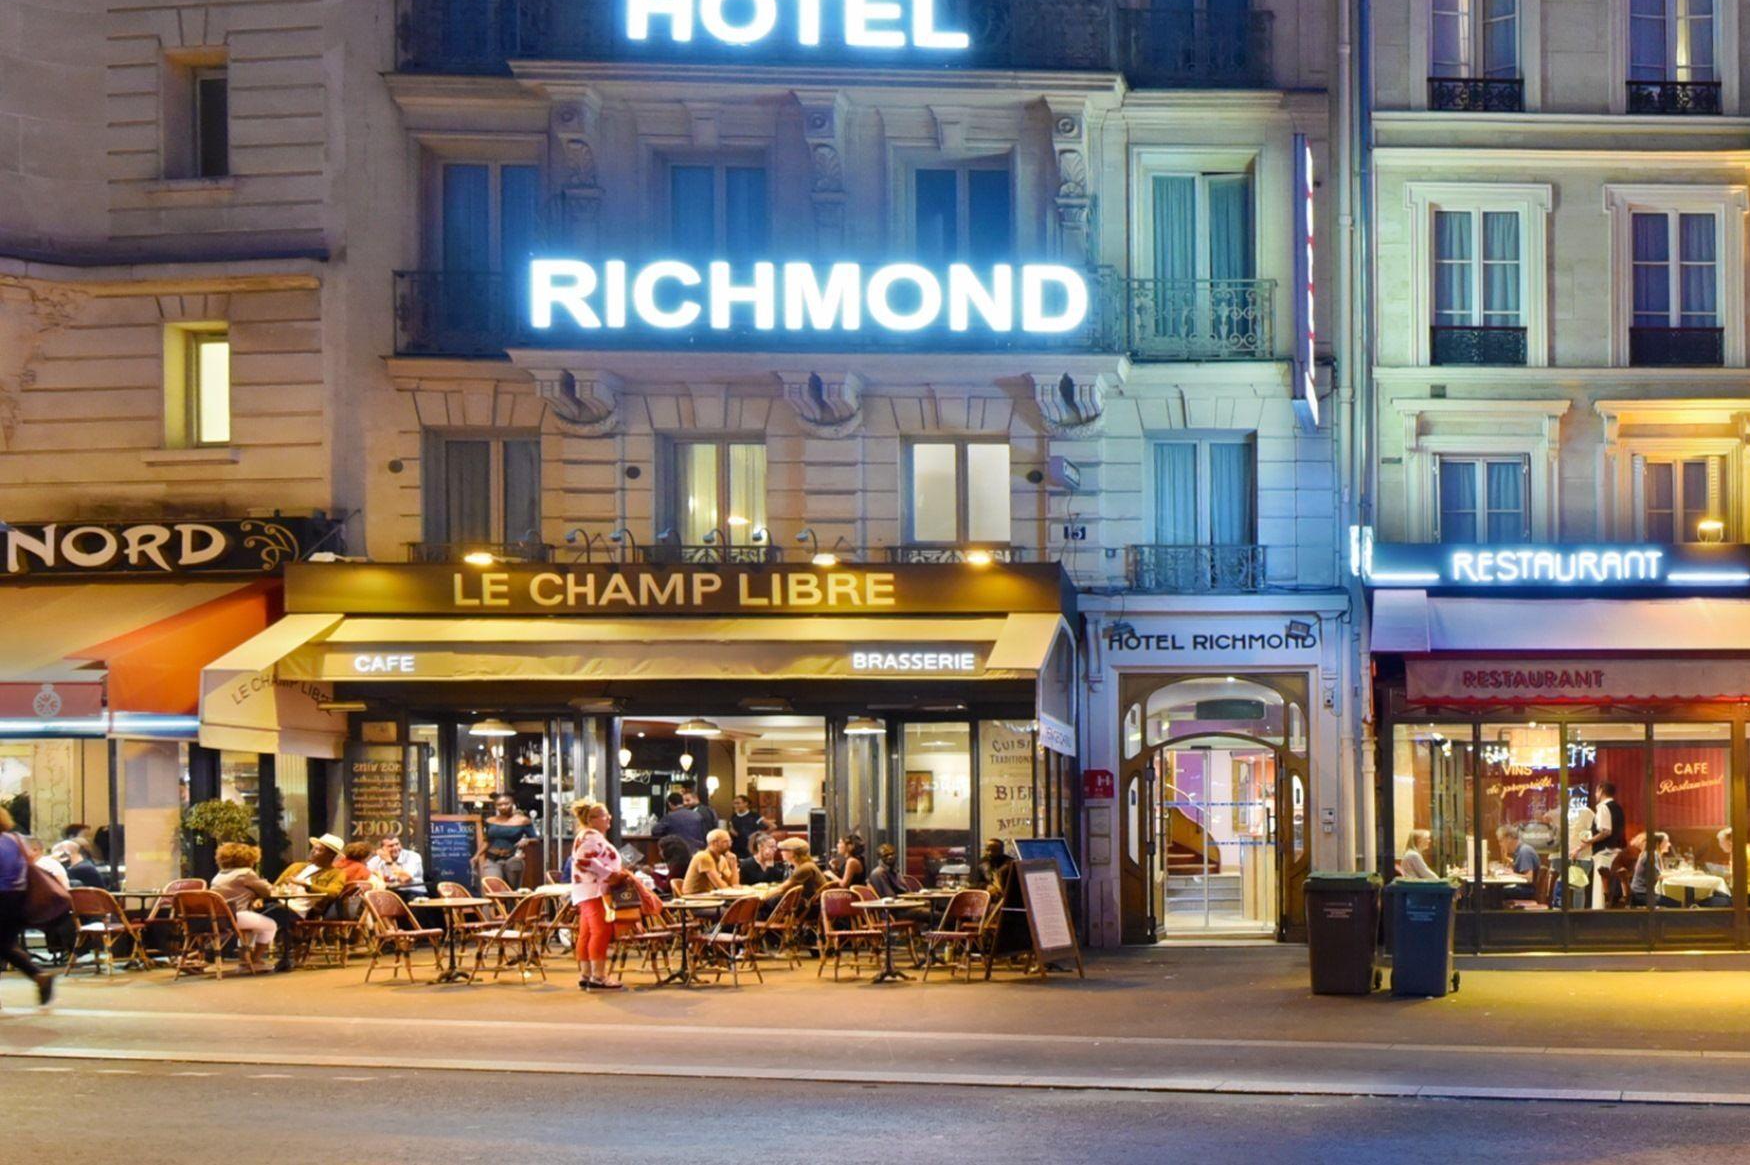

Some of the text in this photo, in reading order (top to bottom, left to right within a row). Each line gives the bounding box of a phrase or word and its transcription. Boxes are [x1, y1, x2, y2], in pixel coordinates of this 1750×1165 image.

[529, 257, 1090, 334] RICHMOND
[6, 523, 227, 573] NORD
[1452, 550, 1663, 582] RESTAURANT
[453, 573, 896, 606] LE CHAMP LIBRE
[1192, 633, 1317, 651] RICHMOND
[354, 654, 416, 673] CAFE
[851, 651, 976, 671] BRASSERIE
[1463, 670, 1605, 688] RESTAURANT
[231, 684, 251, 706] LE
[1502, 765, 1533, 776] VINS
[1674, 762, 1708, 775] CAFE
